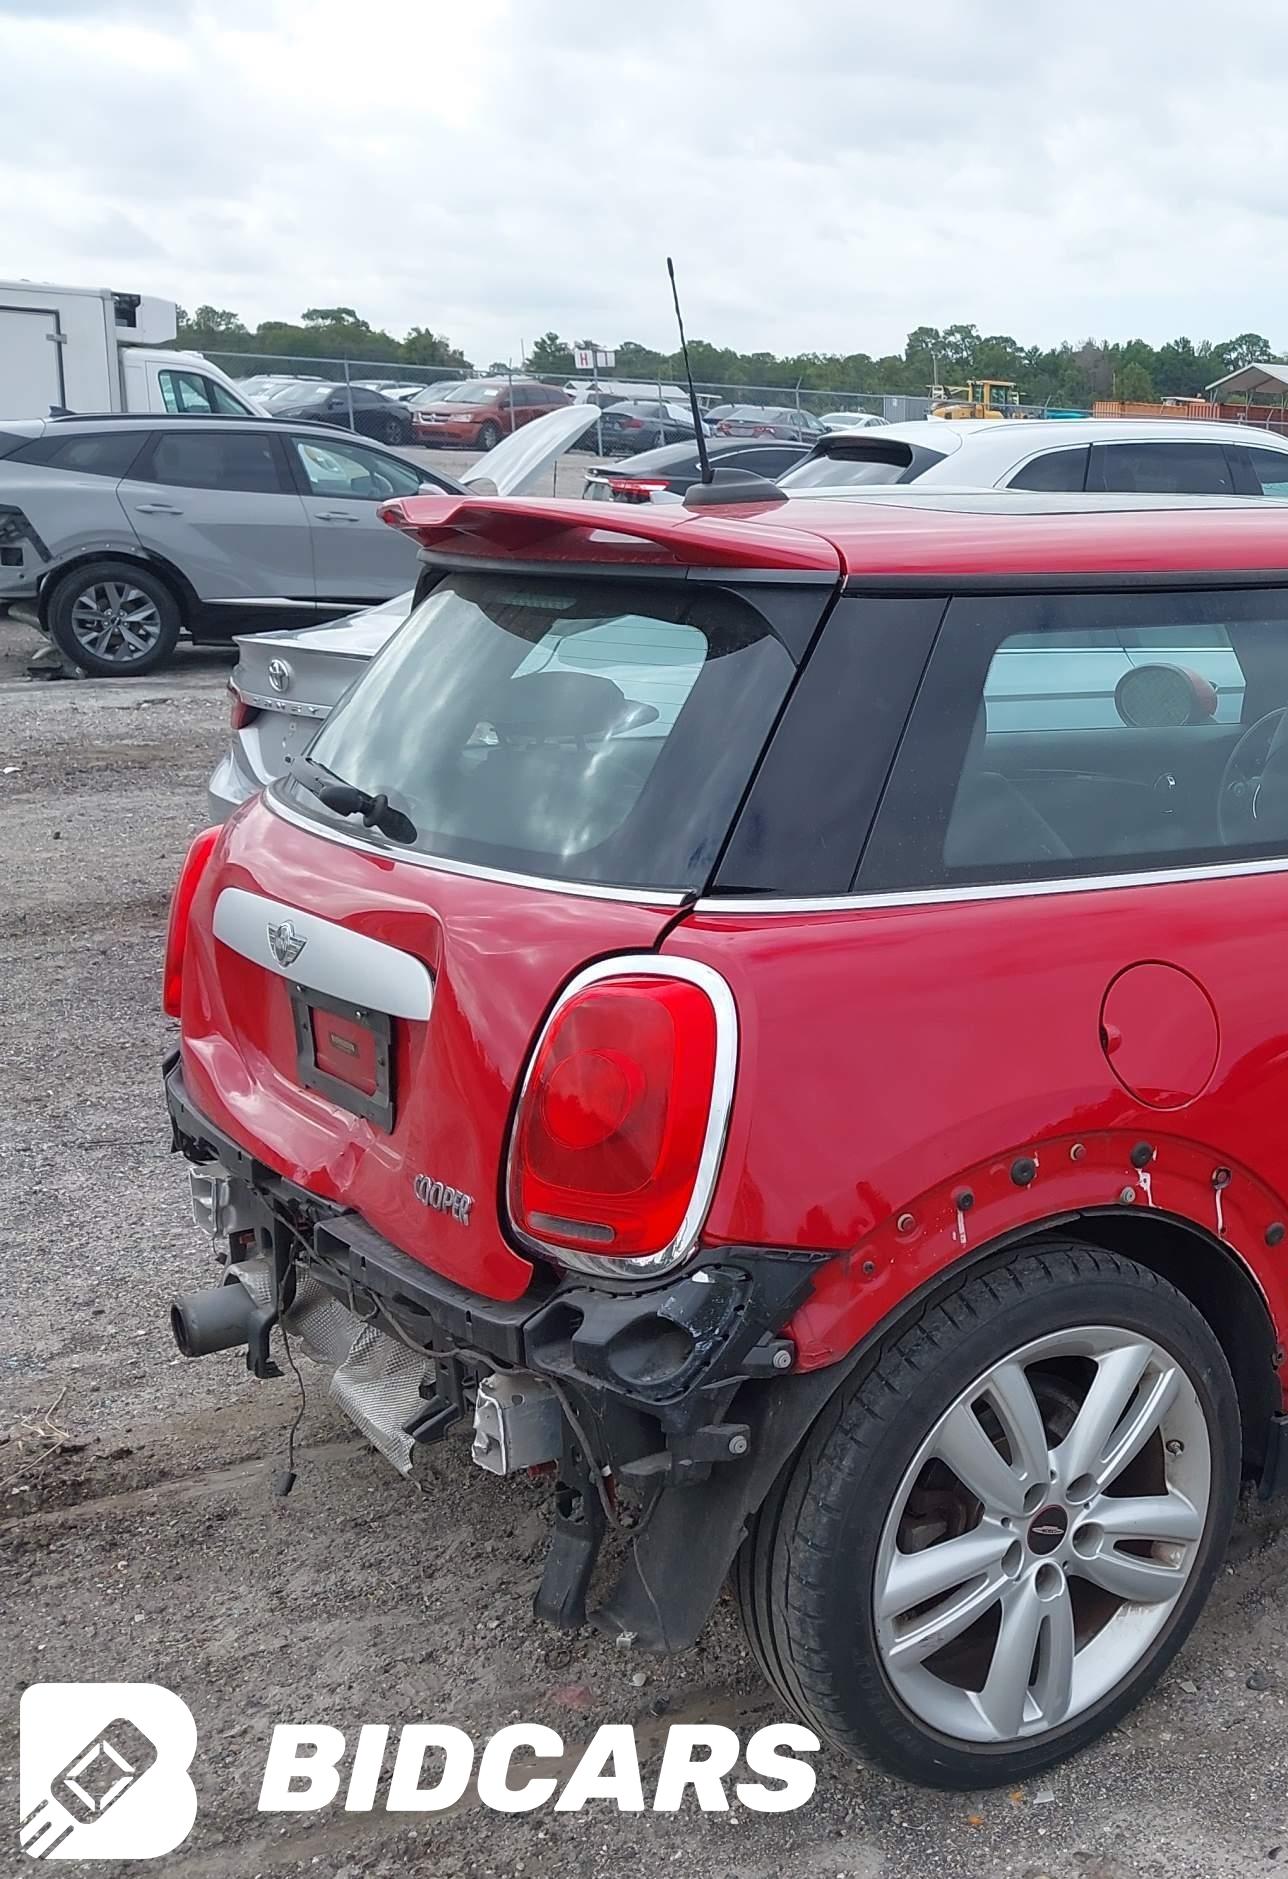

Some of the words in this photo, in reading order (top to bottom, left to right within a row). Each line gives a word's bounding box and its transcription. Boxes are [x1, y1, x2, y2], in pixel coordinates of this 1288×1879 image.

[580, 351, 588, 367] H
[252, 697, 320, 715] CAMRY
[415, 1173, 472, 1227] COOPER
